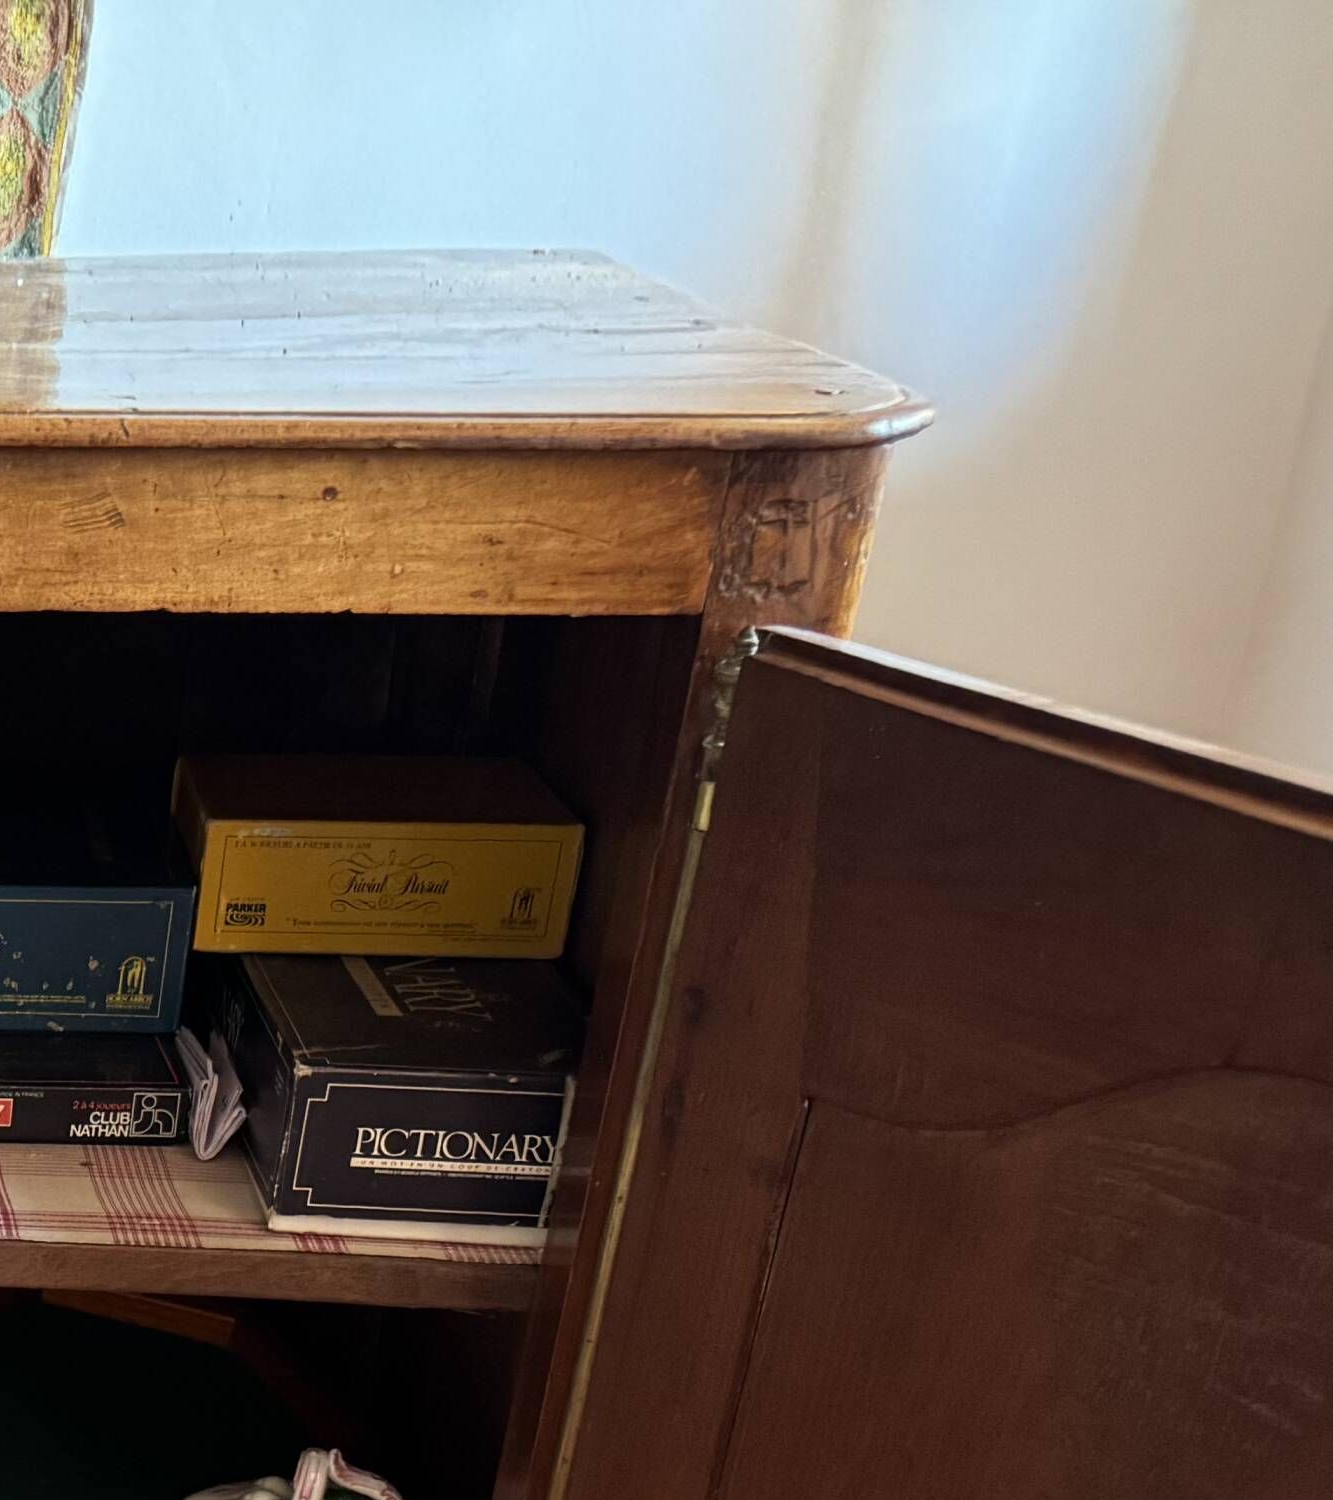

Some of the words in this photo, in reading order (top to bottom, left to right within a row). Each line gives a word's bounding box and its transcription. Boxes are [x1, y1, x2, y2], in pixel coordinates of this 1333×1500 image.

[330, 868, 389, 896] Trivial
[391, 870, 450, 896] Pursuit
[226, 903, 267, 913] PARKER
[90, 1111, 130, 1125] CLUB
[69, 1124, 129, 1138] NATHAN
[353, 1127, 555, 1164] PICTIONARY
